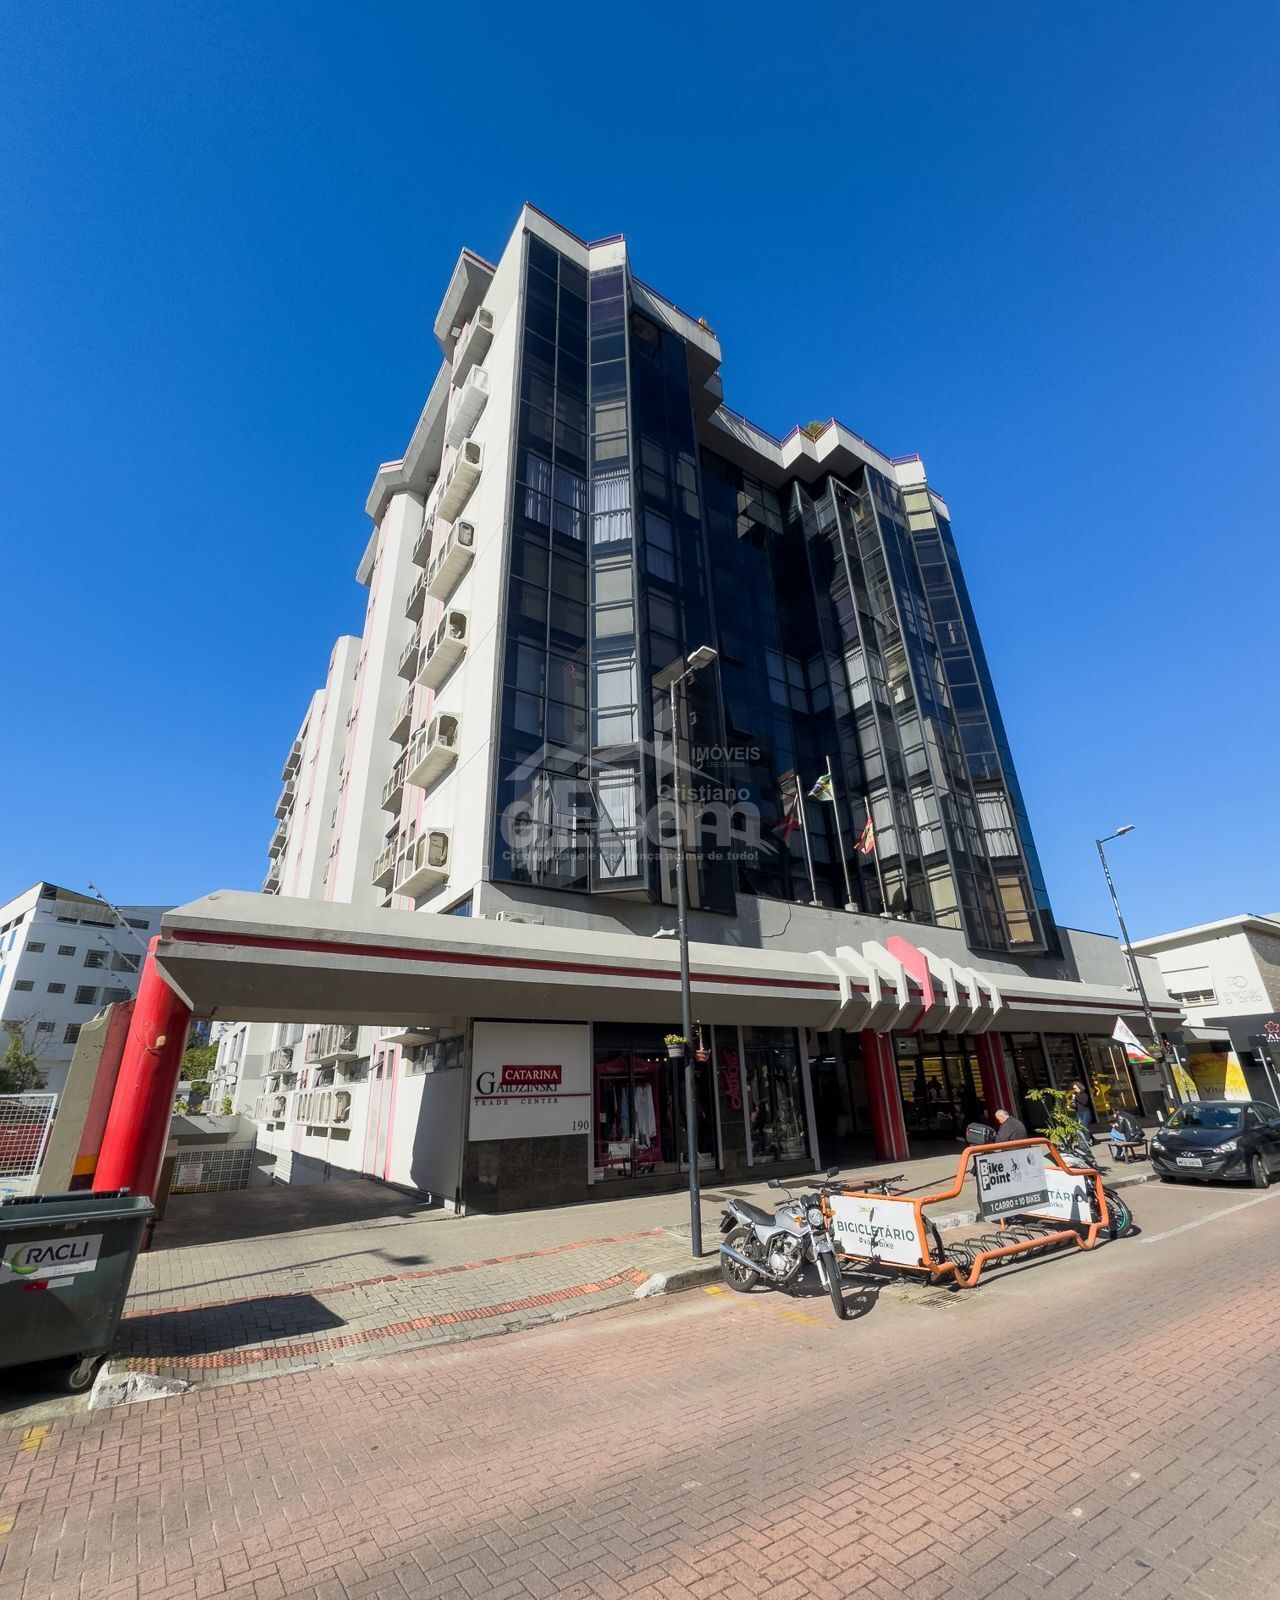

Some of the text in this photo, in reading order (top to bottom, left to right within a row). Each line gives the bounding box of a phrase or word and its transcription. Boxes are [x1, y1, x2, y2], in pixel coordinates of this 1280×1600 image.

[505, 1070, 559, 1080] CATARINA
[571, 1120, 589, 1131] 190
[980, 1160, 1004, 1175] Bike
[982, 1172, 1011, 1191] Point
[994, 1199, 1015, 1211] CARRO
[836, 1221, 915, 1242] BICICLETÁRIO
[25, 1242, 89, 1264] RACLI
